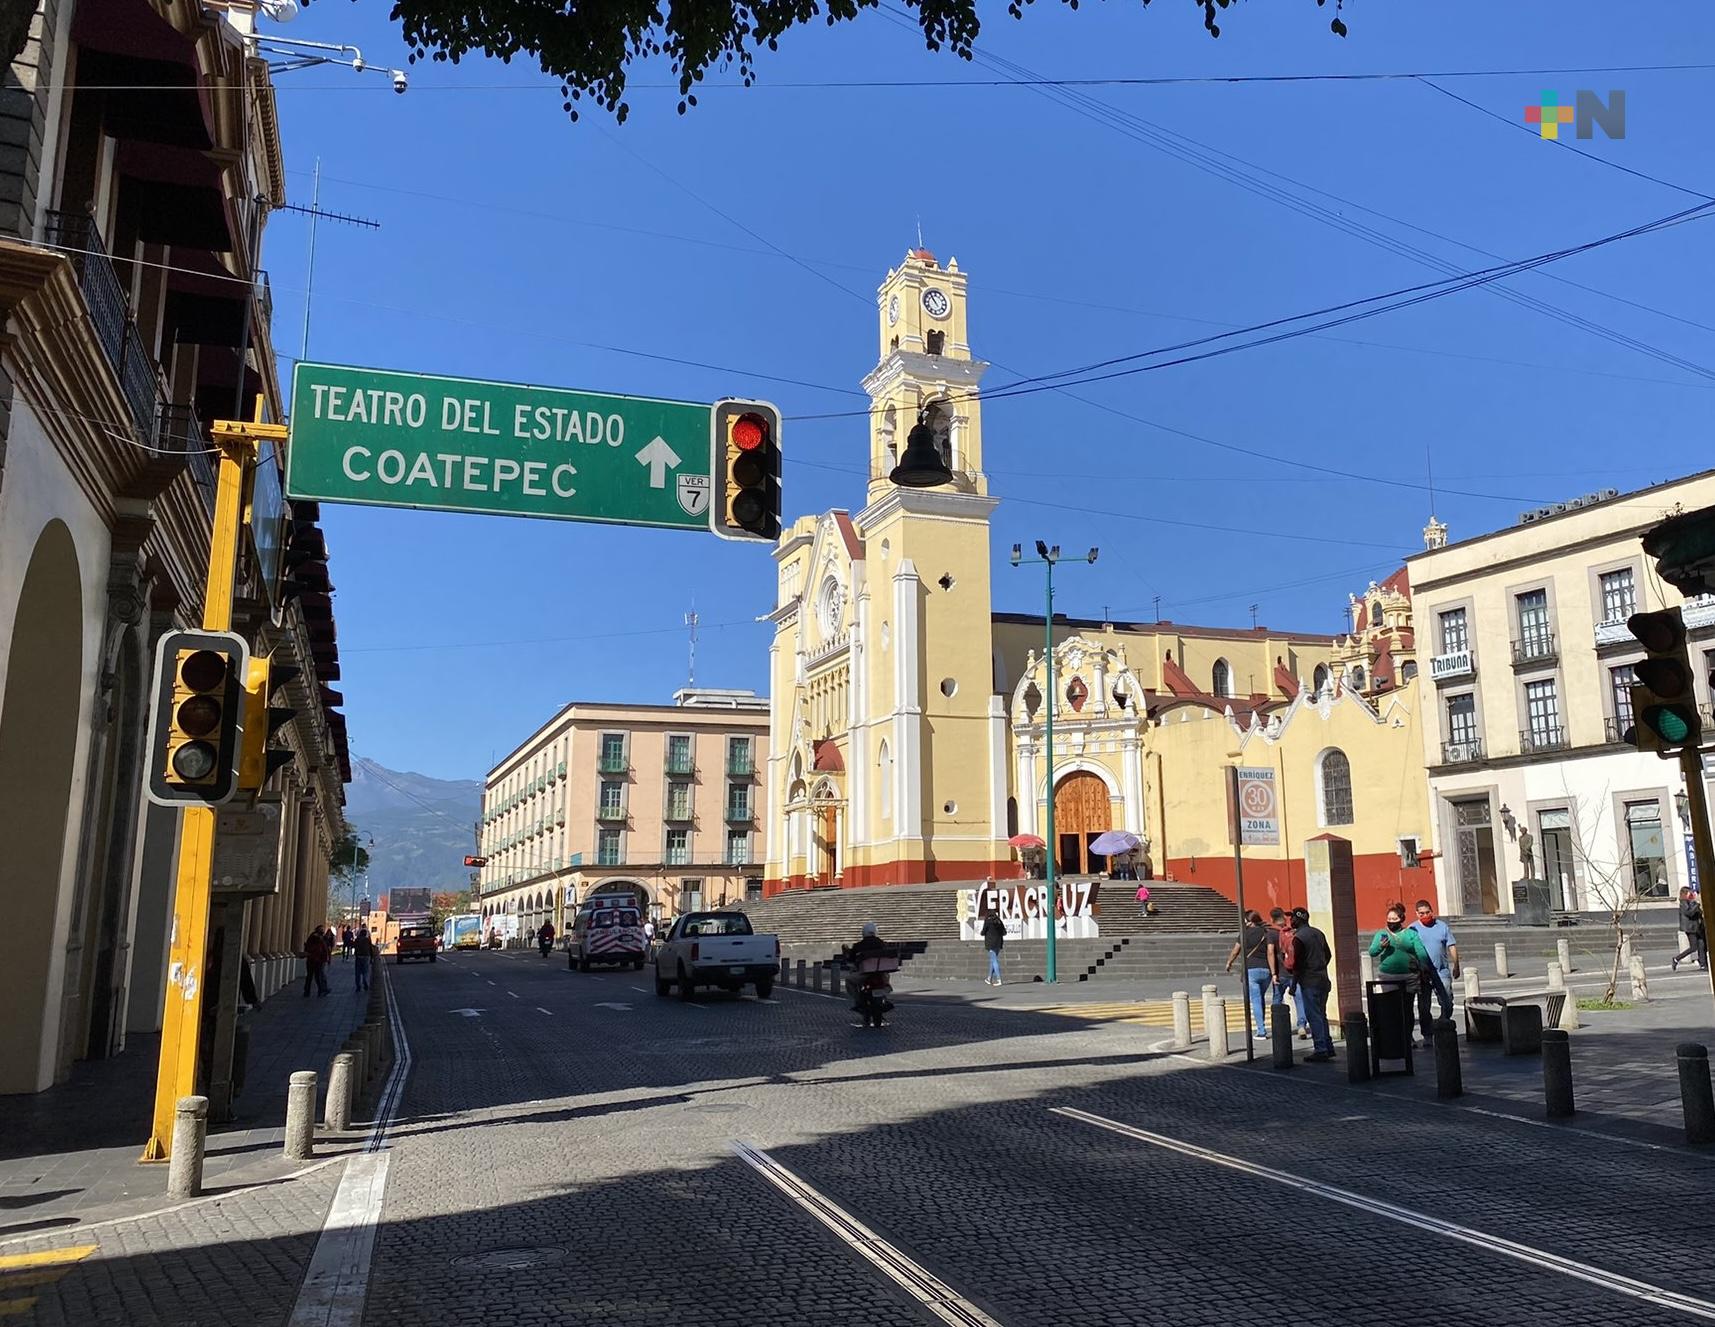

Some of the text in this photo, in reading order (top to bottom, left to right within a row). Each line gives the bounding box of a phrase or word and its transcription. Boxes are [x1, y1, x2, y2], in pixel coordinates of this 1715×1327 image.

[310, 384, 626, 448] TEATRO DEL ESTADO
[342, 445, 578, 498] COATEPEC
[685, 477, 704, 486] VER
[687, 490, 701, 508] 7
[1248, 787, 1267, 805] 30
[1247, 820, 1271, 829] ZONA
[1688, 845, 1697, 890] ABIERT
[964, 881, 1094, 920] VERACRUZ
